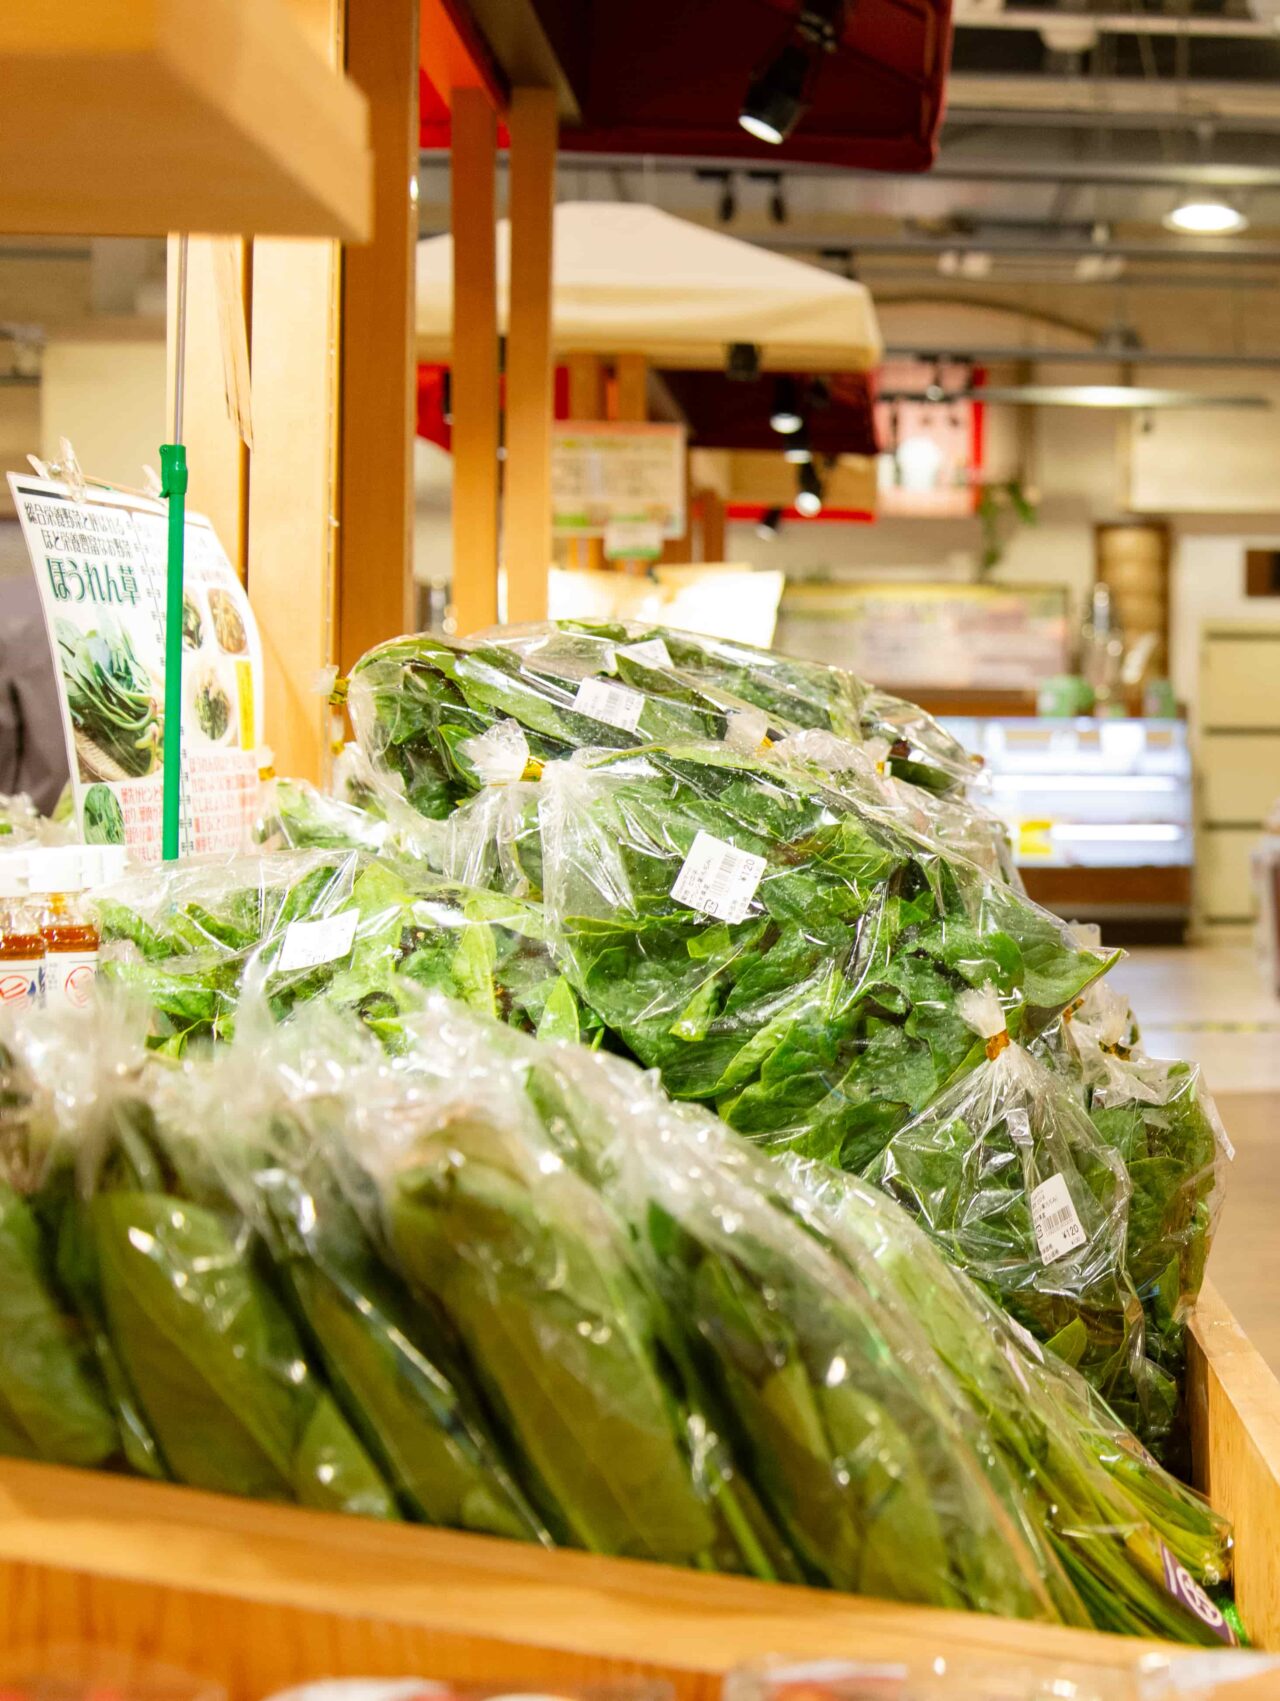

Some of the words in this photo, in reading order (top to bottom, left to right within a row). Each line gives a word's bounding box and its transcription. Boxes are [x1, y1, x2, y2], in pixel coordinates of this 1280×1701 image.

[47, 557, 140, 606] ほうれん草
[1062, 1224, 1079, 1239] ¥120
